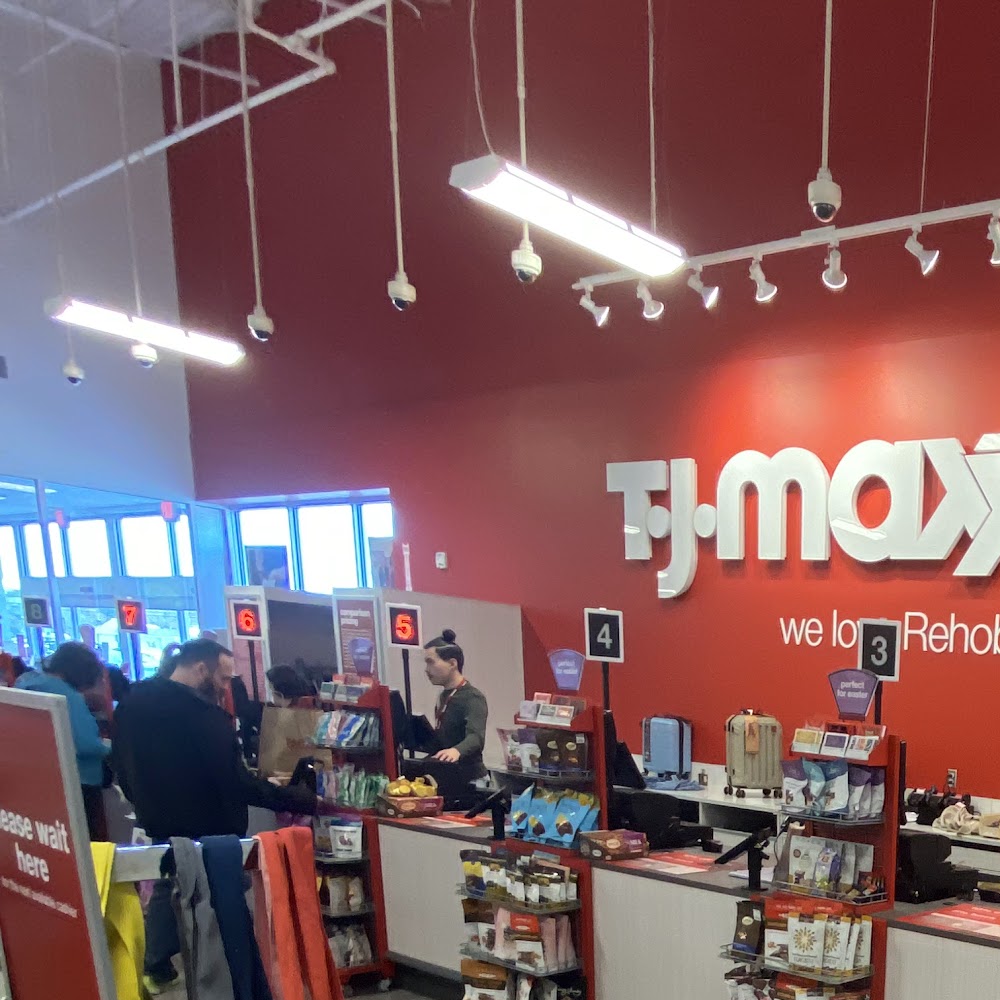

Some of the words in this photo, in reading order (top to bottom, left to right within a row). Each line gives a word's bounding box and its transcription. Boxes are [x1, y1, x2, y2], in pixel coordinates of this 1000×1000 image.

[121, 604, 137, 627] 7
[238, 607, 257, 633] 6
[395, 613, 415, 640] 5
[779, 617, 823, 647] we
[832, 609, 860, 648] lo
[597, 622, 613, 650] 4
[871, 635, 888, 666] 3
[0, 808, 34, 840] ease
[35, 819, 71, 854] wait
[15, 841, 50, 882] here
